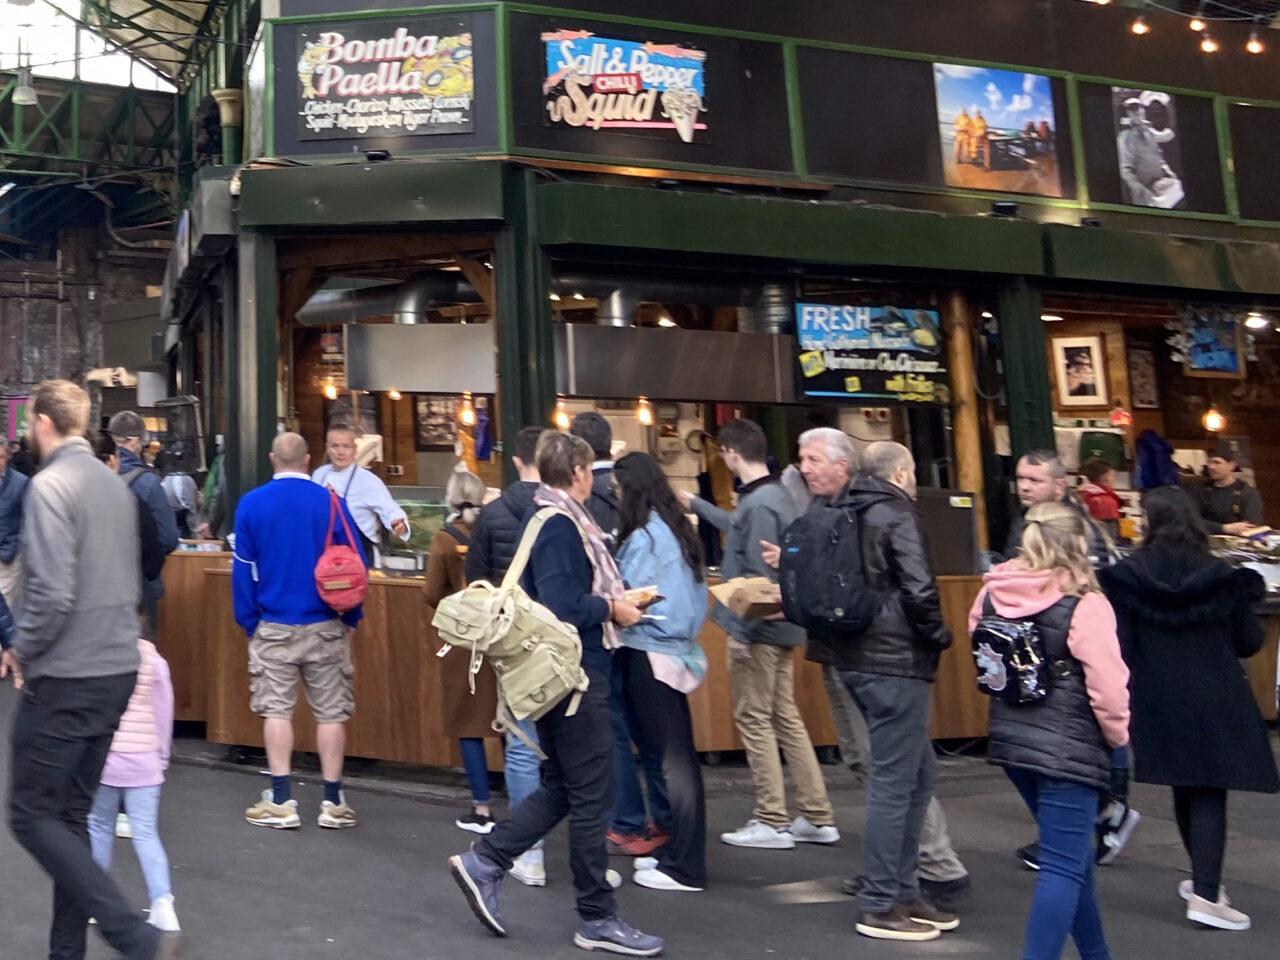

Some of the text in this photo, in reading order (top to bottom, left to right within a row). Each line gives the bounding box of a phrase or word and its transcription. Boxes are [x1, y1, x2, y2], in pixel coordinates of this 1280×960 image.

[318, 27, 439, 64] Bomba
[558, 39, 699, 89] Salt & Pepper
[316, 61, 422, 98] Paella
[546, 70, 658, 131] Squid
[801, 305, 870, 332] FRESH
